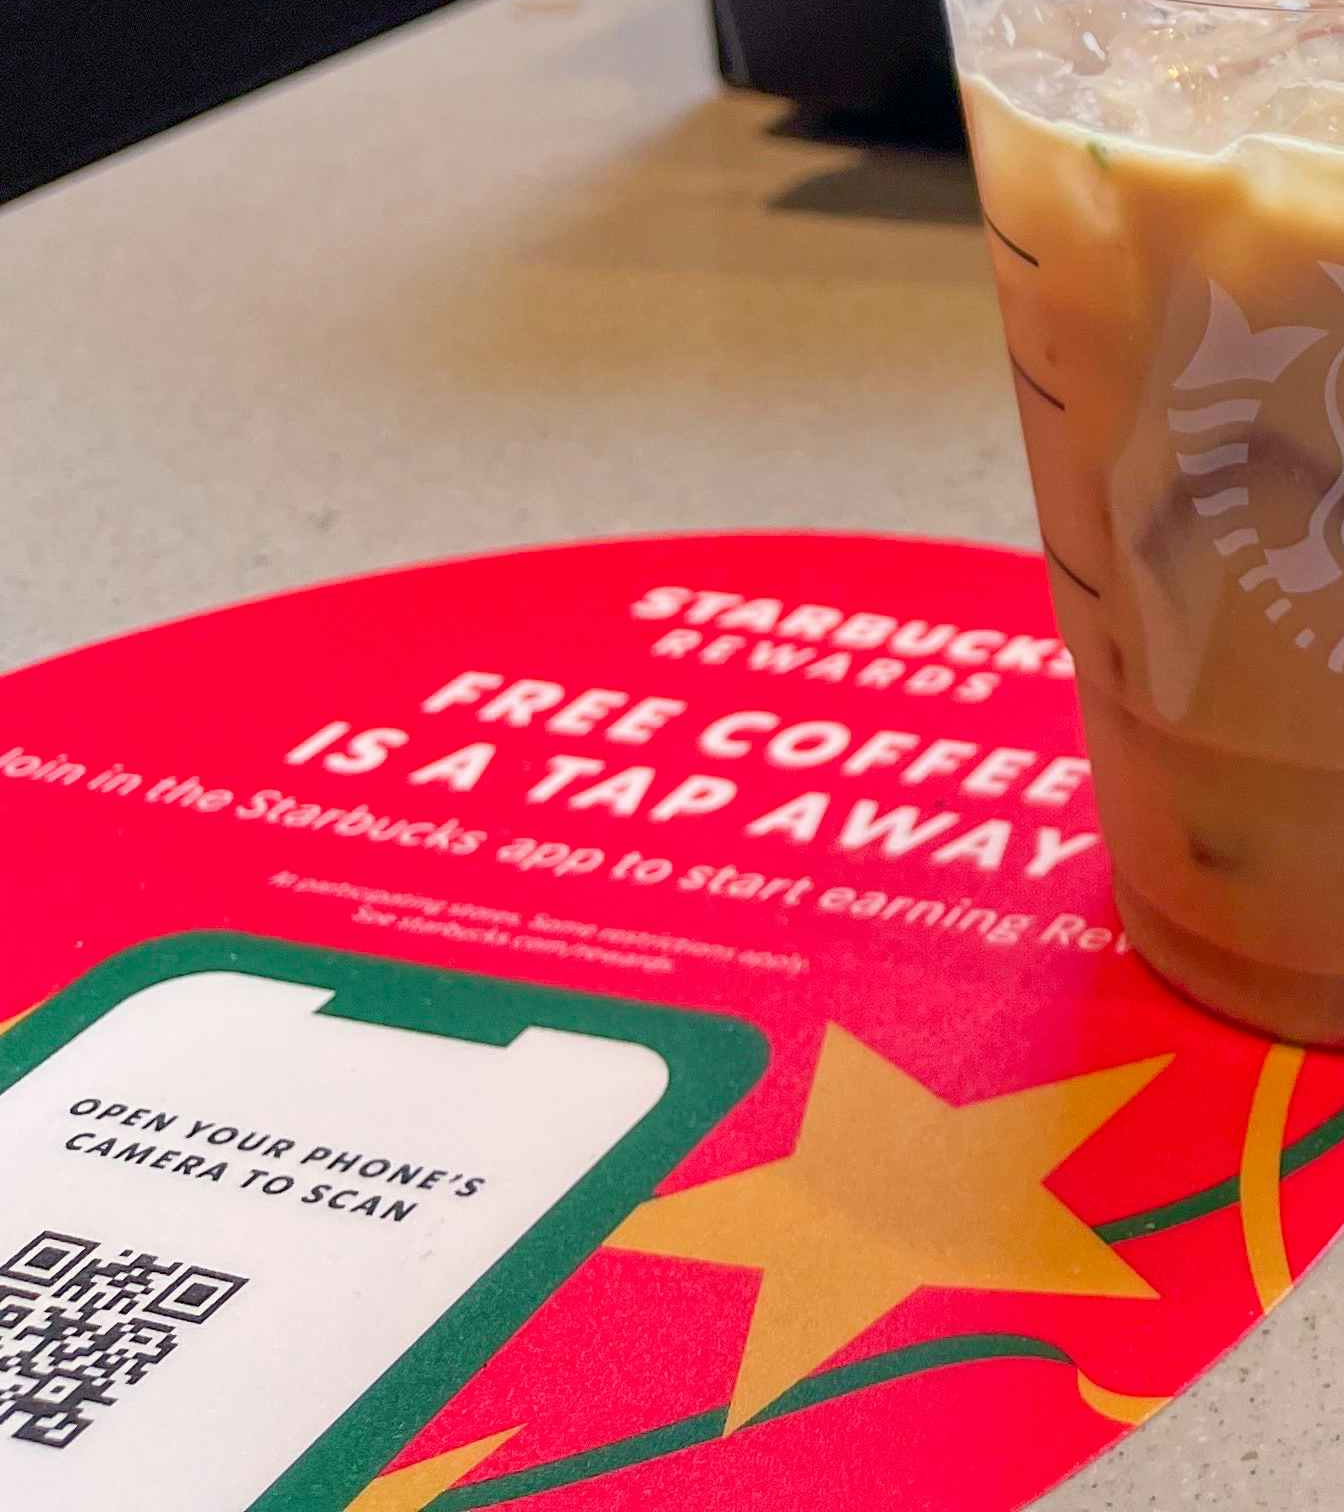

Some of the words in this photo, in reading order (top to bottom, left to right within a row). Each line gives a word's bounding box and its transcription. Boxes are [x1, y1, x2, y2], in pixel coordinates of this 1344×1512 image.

[652, 627, 1002, 703] REWARDS
[419, 670, 688, 745] FREE
[697, 710, 1091, 807] COFFEE
[86, 762, 143, 797] in
[144, 775, 234, 814] the
[234, 788, 487, 856] Starbucks
[496, 836, 605, 875] app
[610, 850, 675, 885] to
[678, 862, 815, 907] start
[815, 886, 1036, 947] earning
[284, 721, 411, 775] IS
[407, 742, 497, 791] A
[524, 754, 738, 824] TAP
[743, 791, 1099, 880] AWAY
[64, 1131, 229, 1182] CAMERA
[240, 1169, 296, 1196] TO
[301, 1183, 418, 1223] SCAN
[68, 1097, 179, 1134] OPEN
[184, 1119, 296, 1160] YOUR
[301, 1145, 488, 1199] PHONE'S
